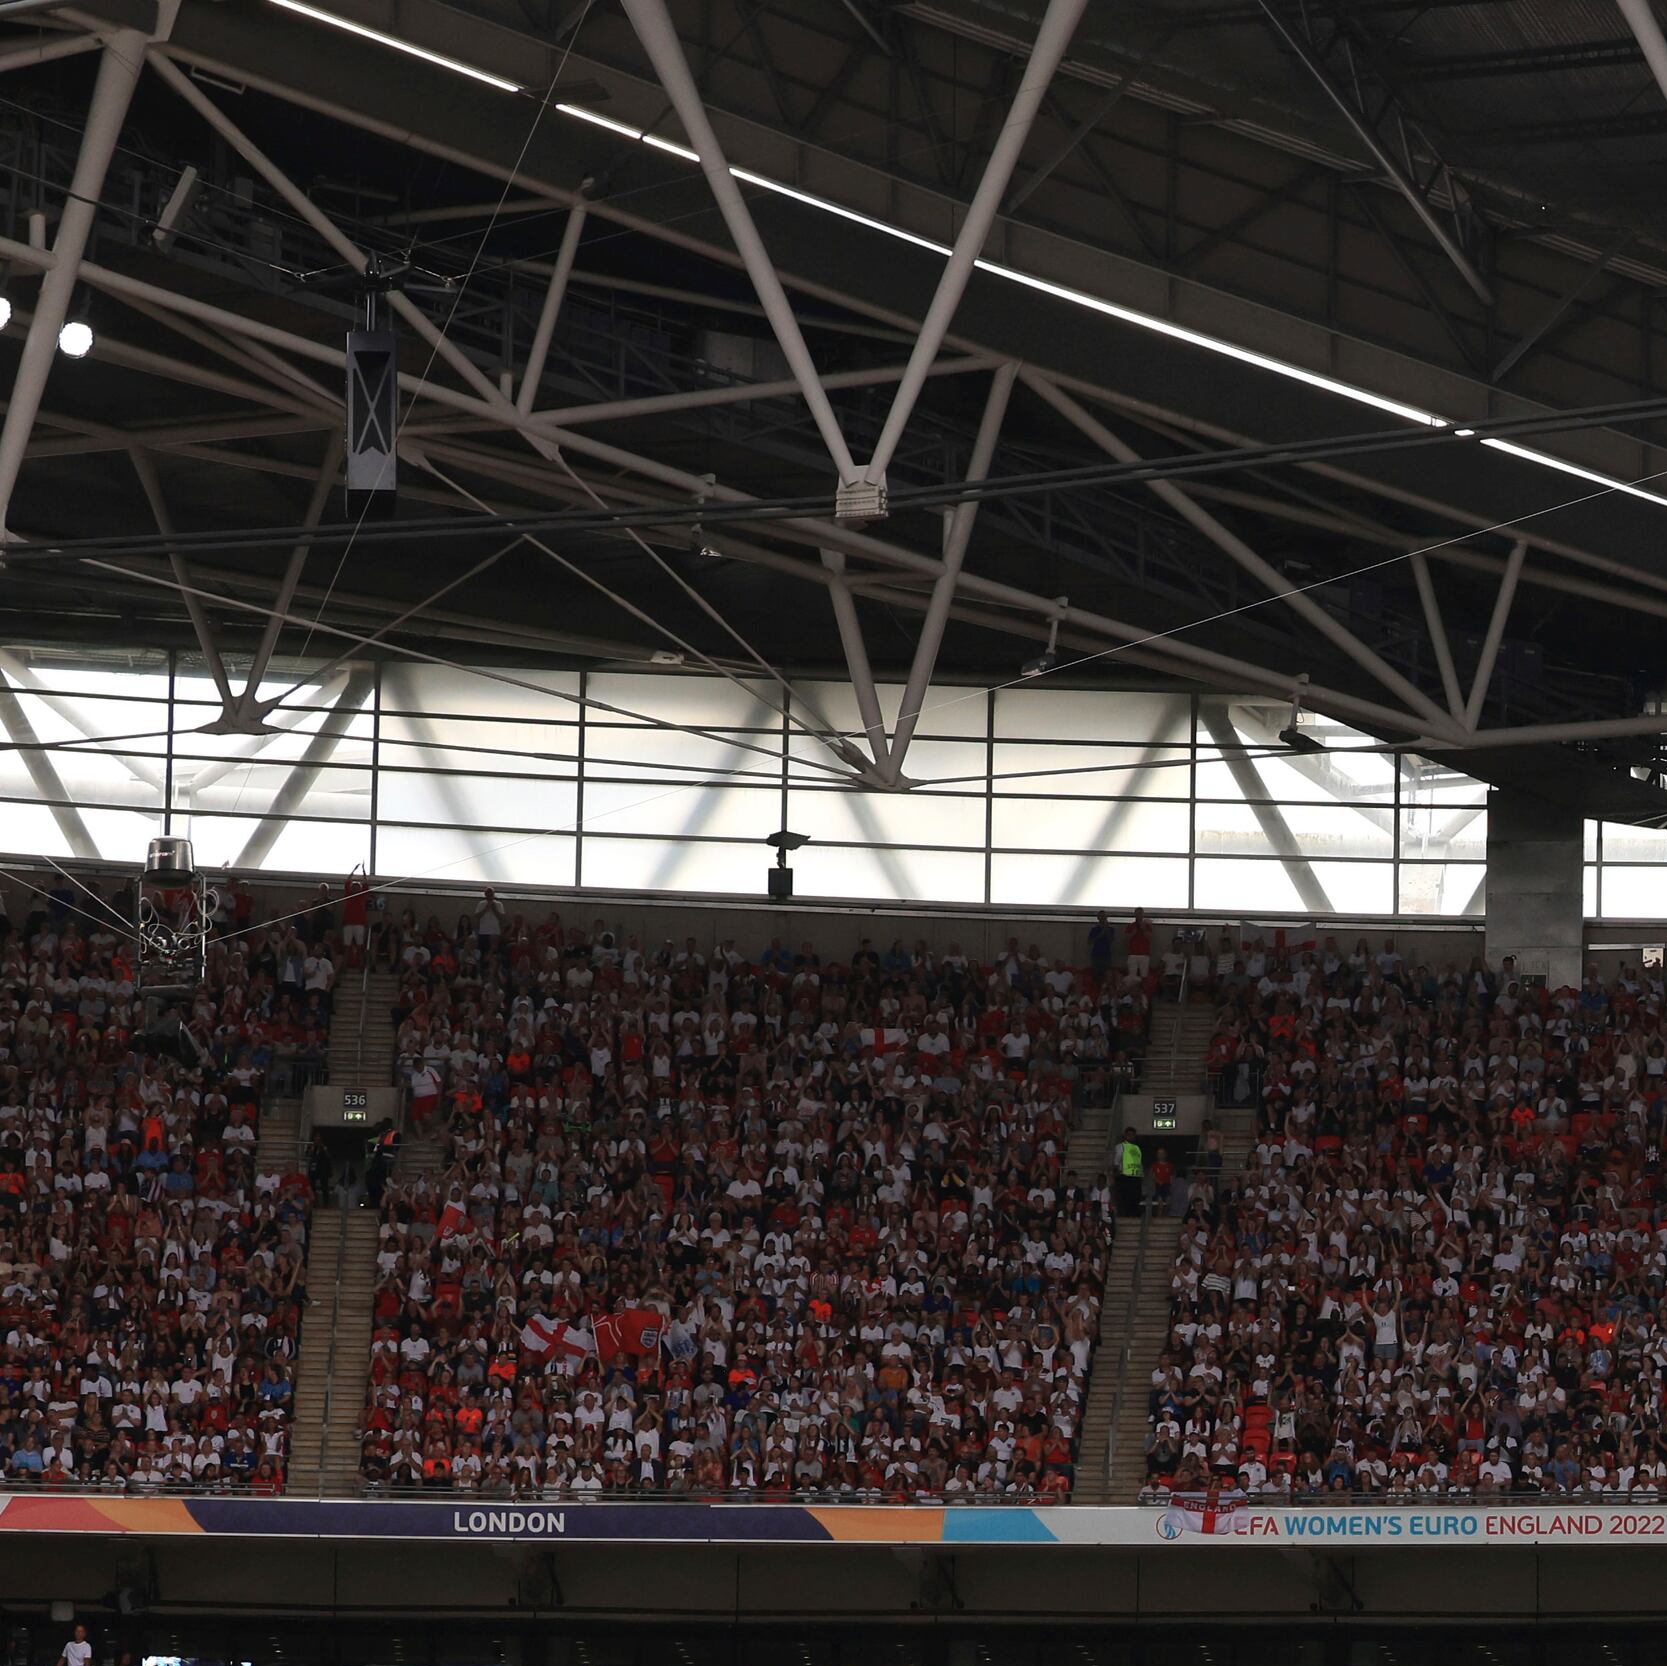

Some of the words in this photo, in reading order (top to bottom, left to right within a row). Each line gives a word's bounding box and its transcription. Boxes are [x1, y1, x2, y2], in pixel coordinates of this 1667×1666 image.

[343, 1094, 367, 1107] 536
[1154, 1103, 1175, 1114] 537
[454, 1512, 565, 1532] LONDON
[1234, 1516, 1280, 1536] EFA
[1285, 1514, 1402, 1536] WOMEN'S
[1409, 1514, 1478, 1536] EURO
[1485, 1515, 1603, 1535] ENGLAND
